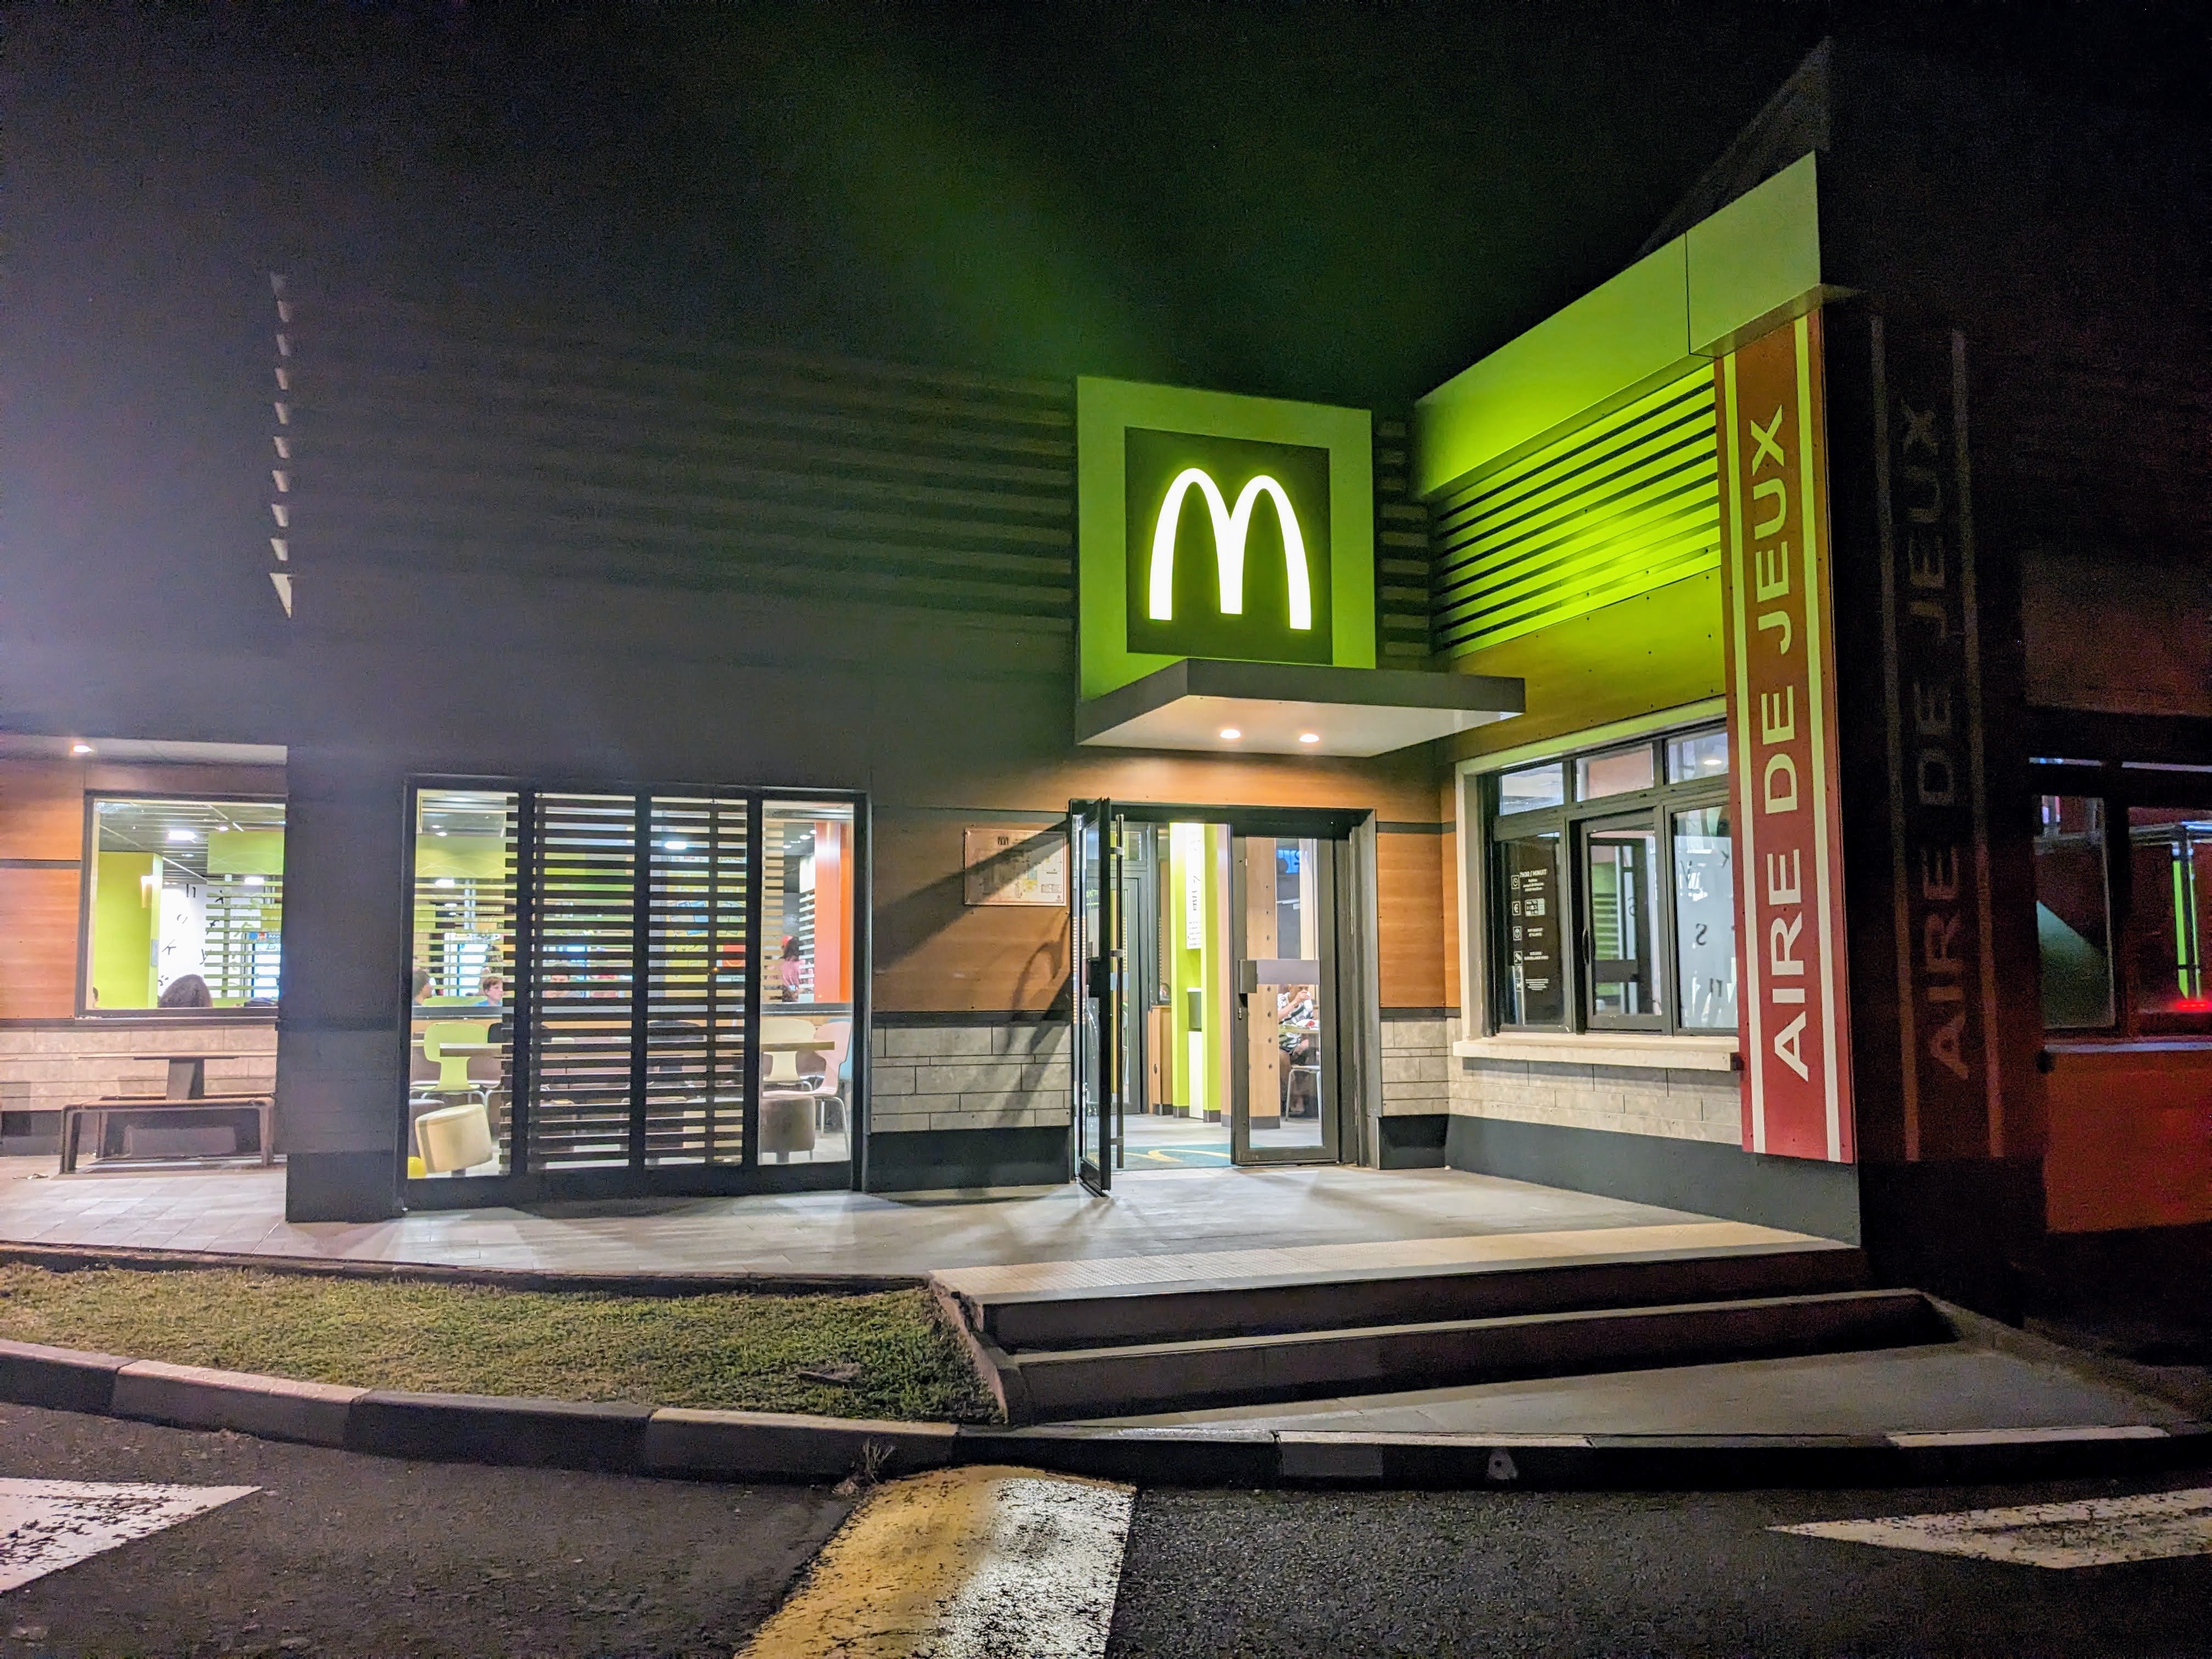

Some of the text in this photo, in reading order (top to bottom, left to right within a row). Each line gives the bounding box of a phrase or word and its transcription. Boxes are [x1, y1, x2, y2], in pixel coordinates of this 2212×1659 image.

[1149, 467, 1311, 630] M
[1750, 404, 1809, 1082] AIRE DE JEUX
[1901, 398, 1970, 1081] AIRE DE JEUX
